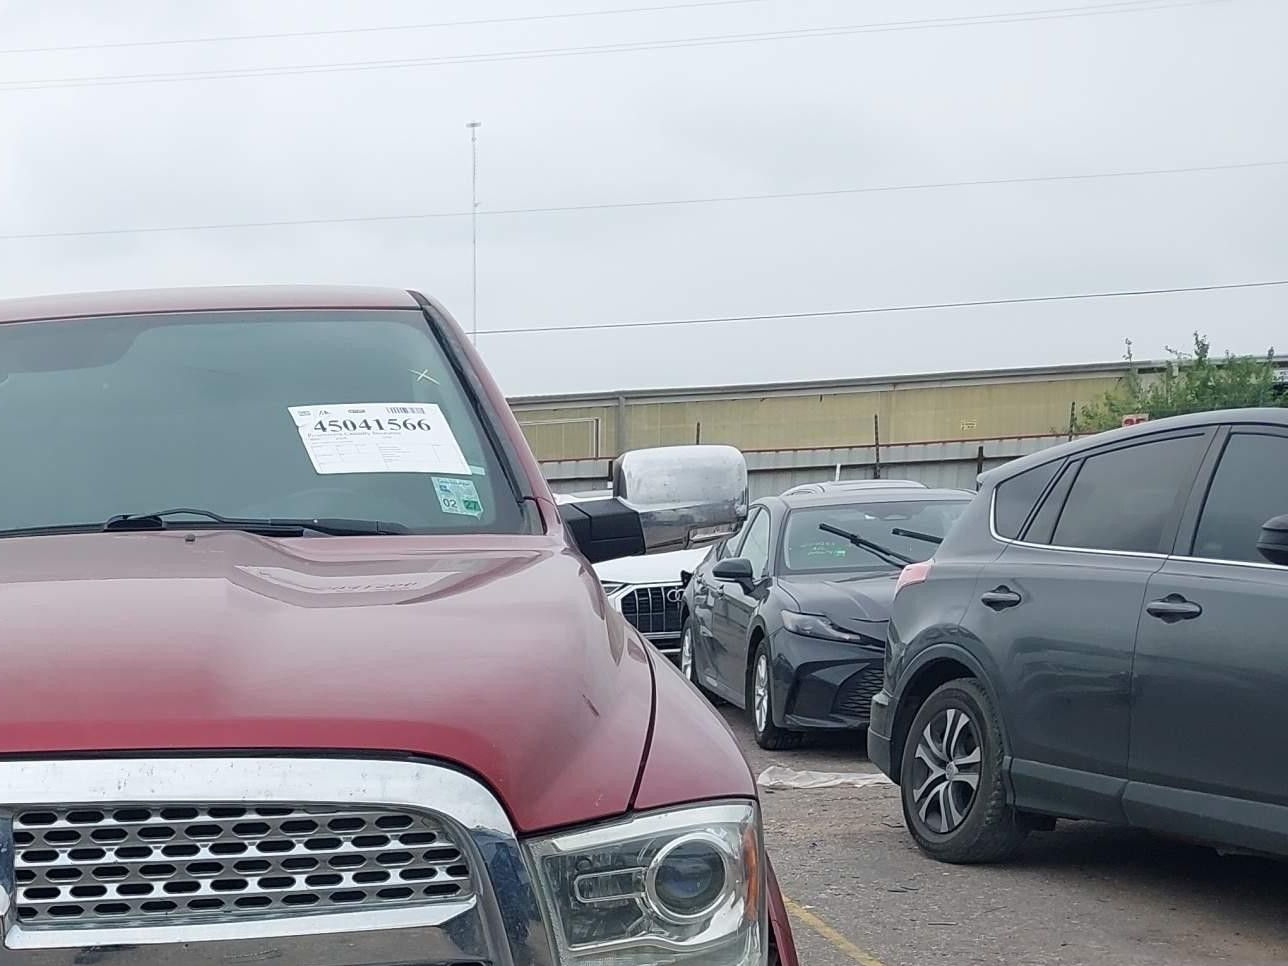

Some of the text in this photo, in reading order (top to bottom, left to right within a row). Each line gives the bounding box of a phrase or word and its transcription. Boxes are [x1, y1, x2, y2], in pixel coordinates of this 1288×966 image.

[313, 418, 432, 433] 45041566
[442, 498, 479, 511] 02 27
